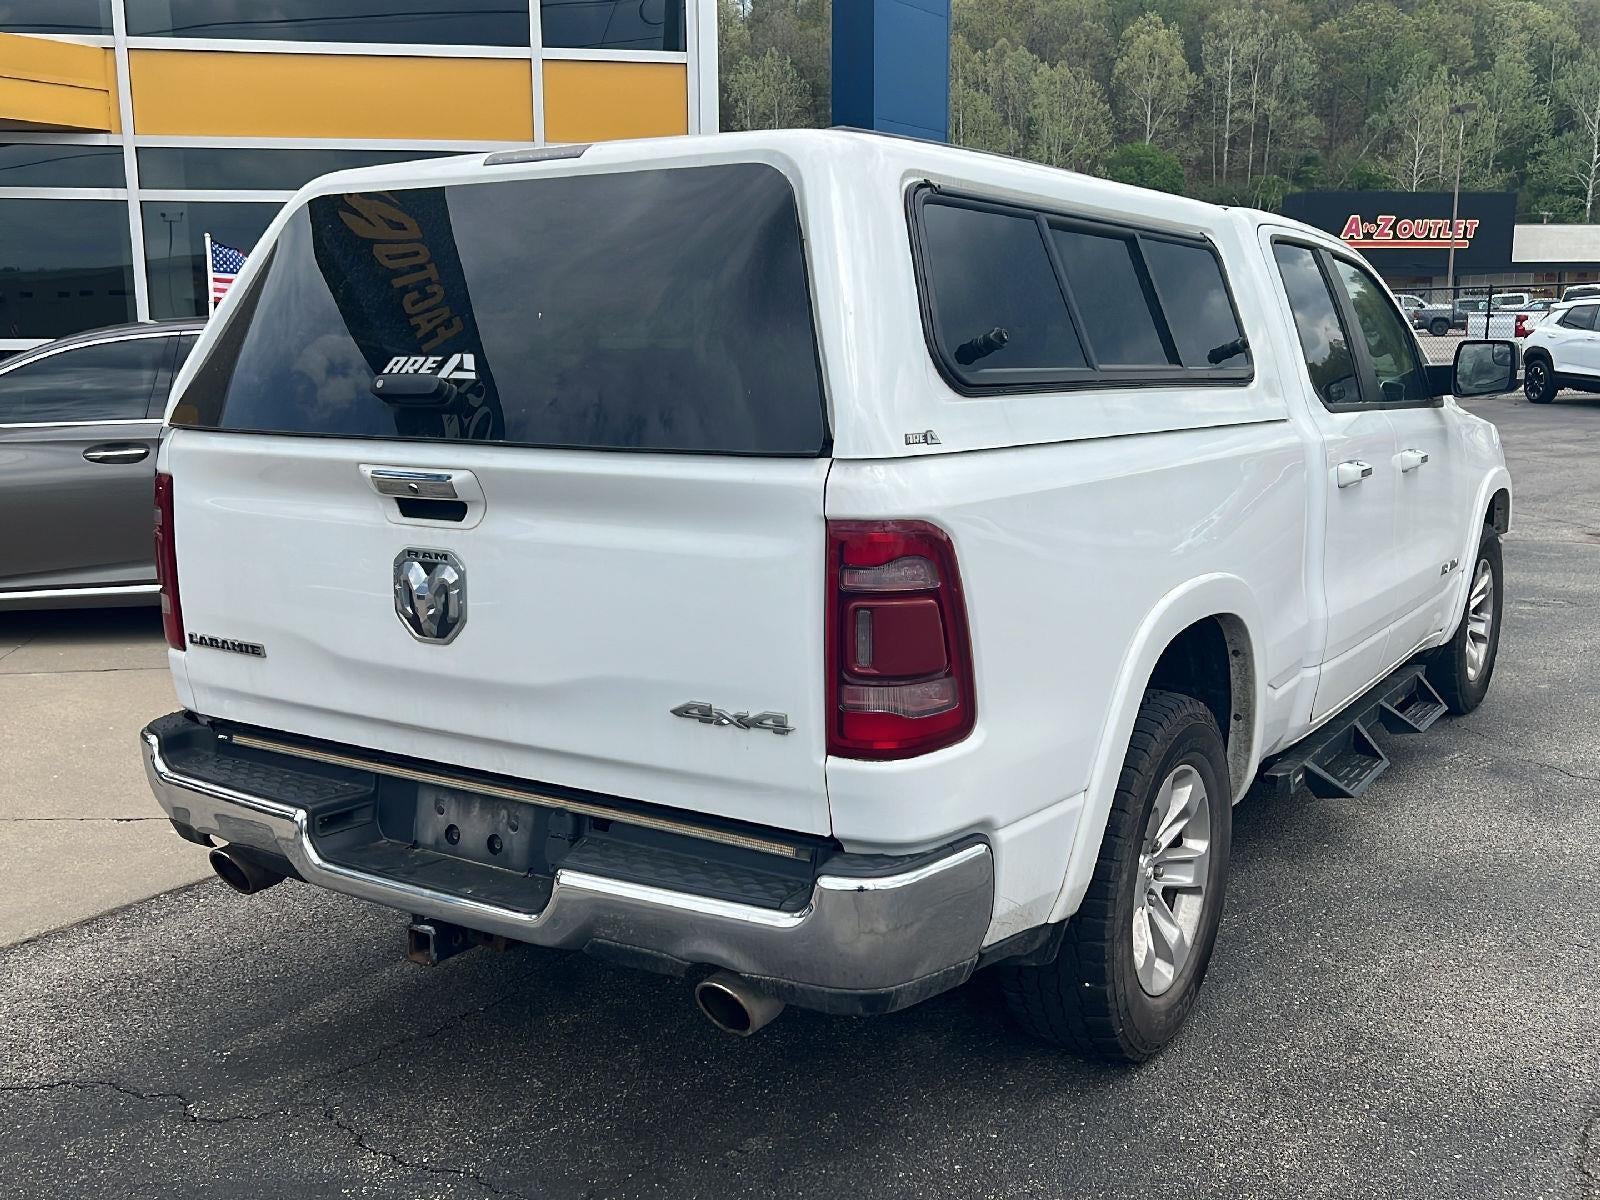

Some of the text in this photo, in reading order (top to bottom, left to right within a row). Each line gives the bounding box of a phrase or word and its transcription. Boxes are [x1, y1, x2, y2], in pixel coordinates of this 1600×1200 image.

[1396, 219, 1480, 239] OUTLET
[407, 550, 448, 561] RAM
[188, 632, 266, 658] LARAMIE
